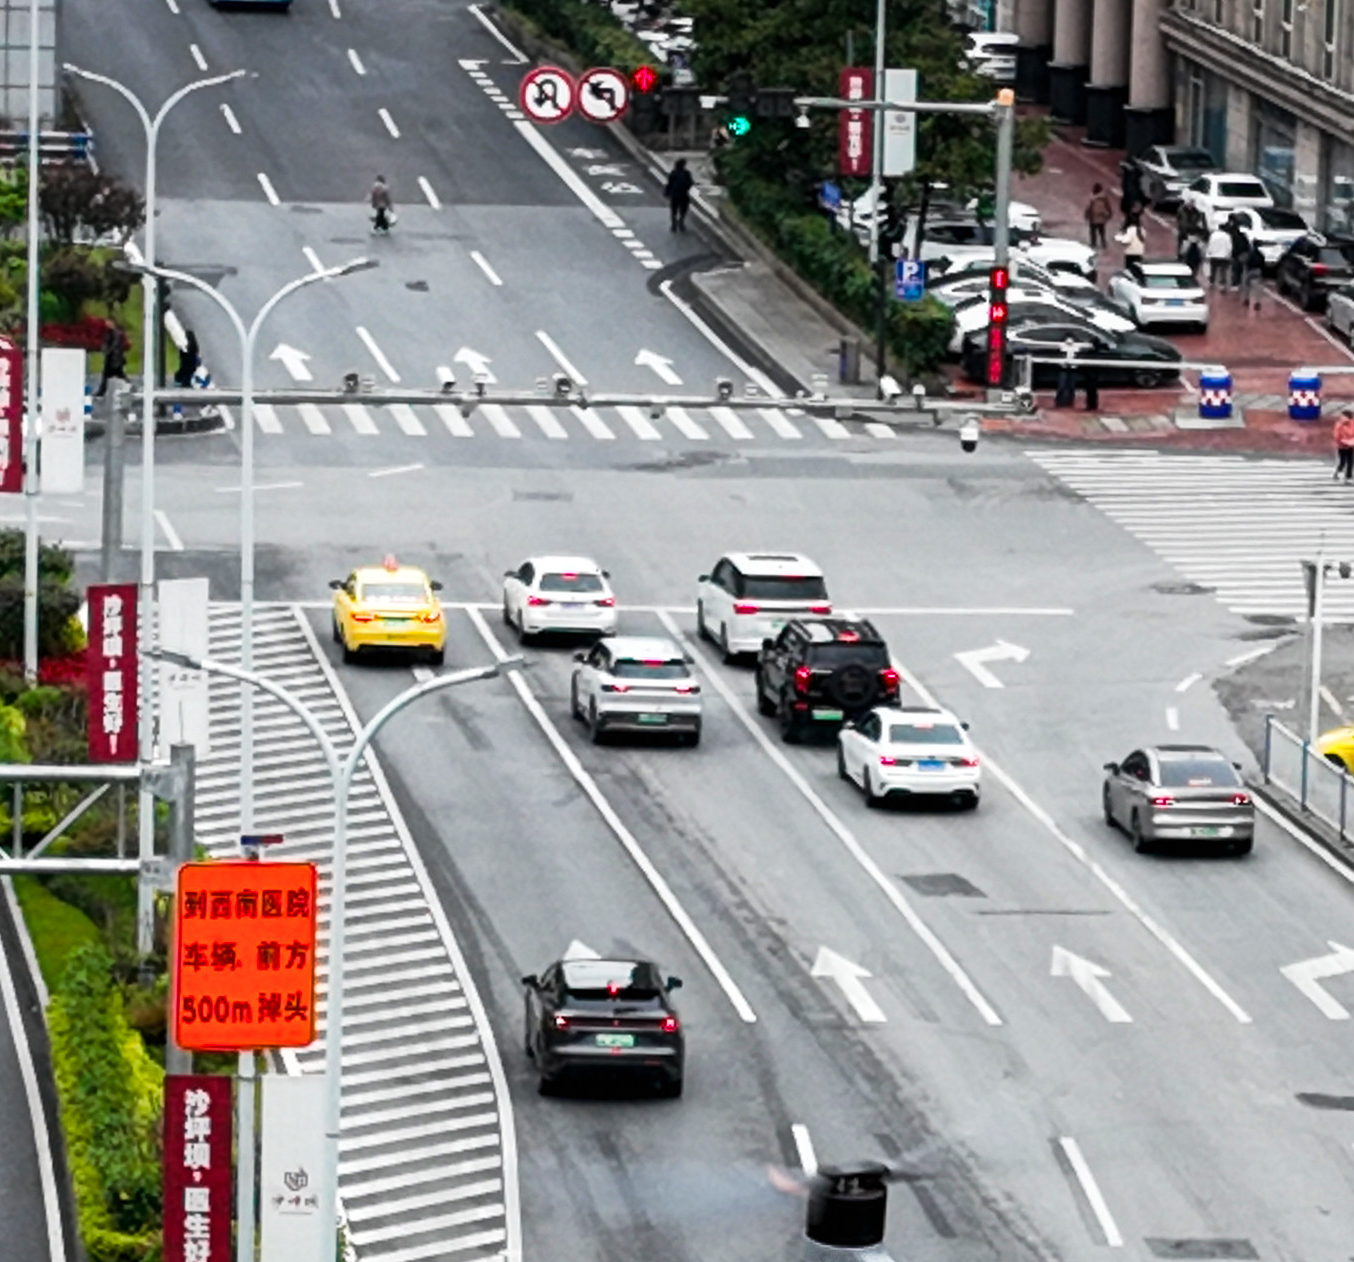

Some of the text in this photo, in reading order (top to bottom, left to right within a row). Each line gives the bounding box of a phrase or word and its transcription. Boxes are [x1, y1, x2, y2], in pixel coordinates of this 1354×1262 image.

[183, 887, 310, 919] 到西南医院
